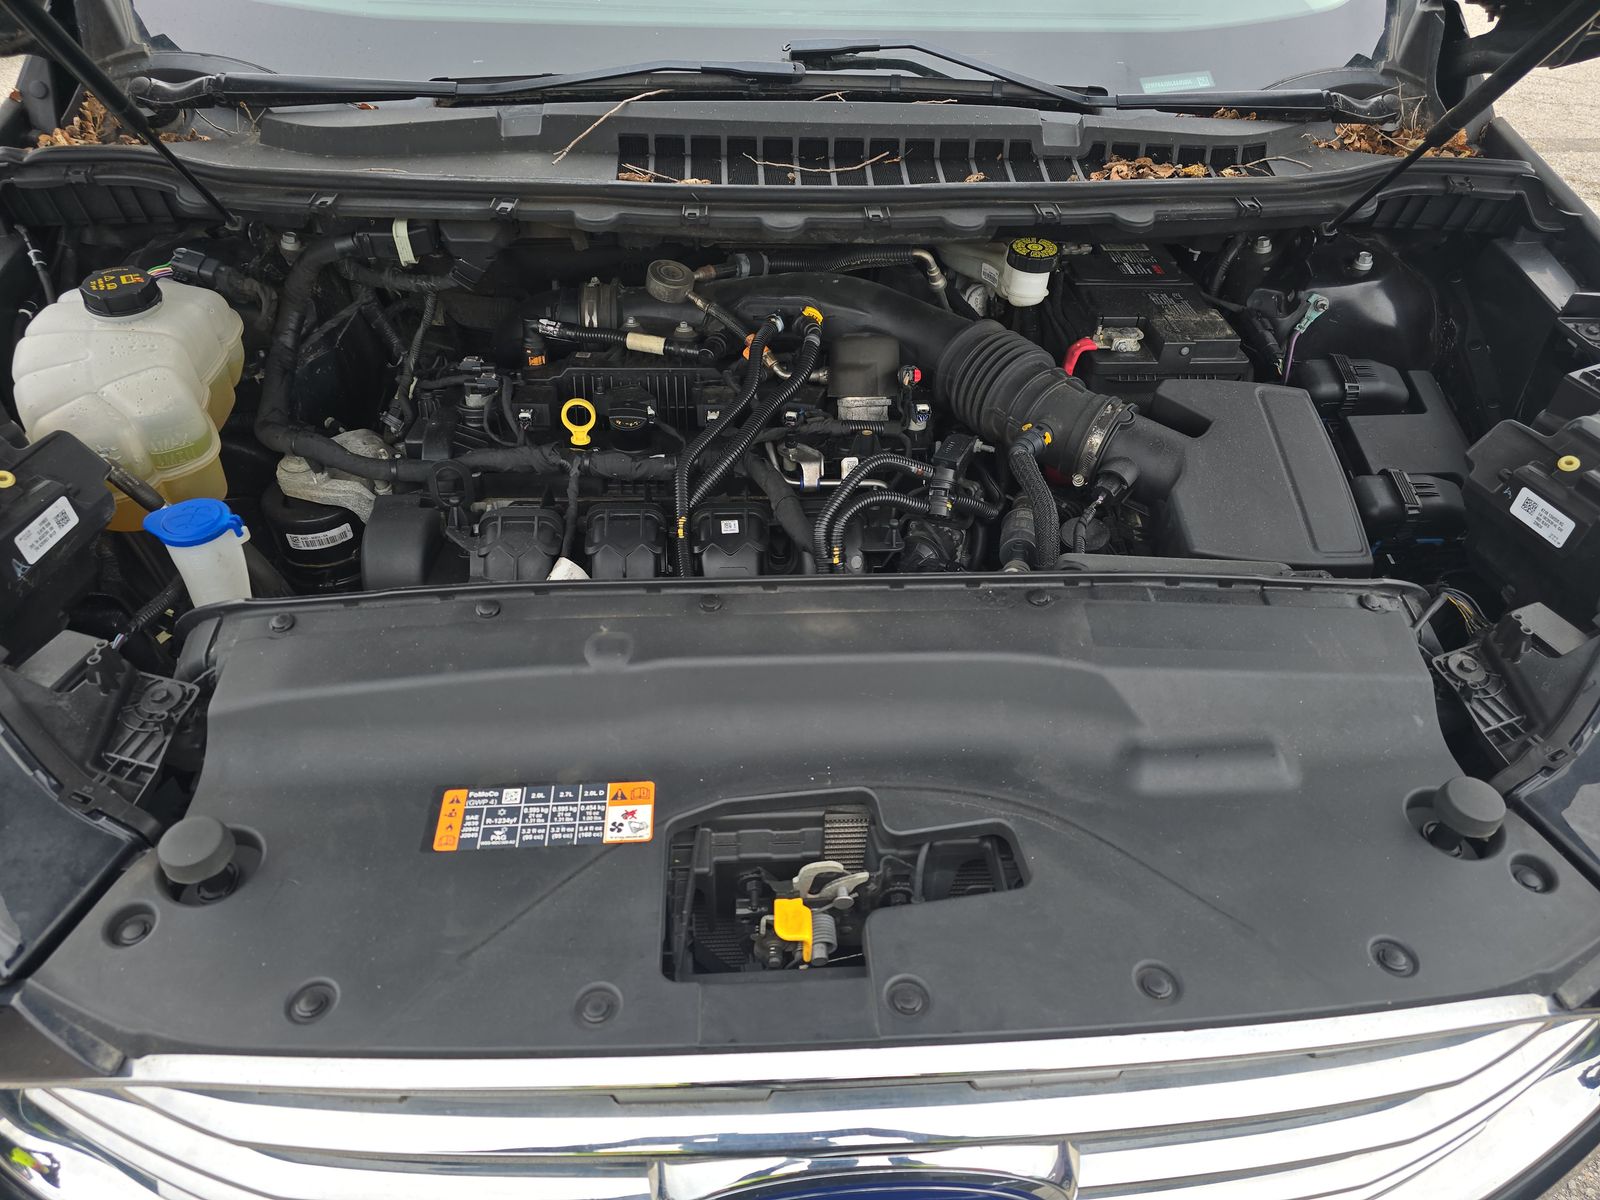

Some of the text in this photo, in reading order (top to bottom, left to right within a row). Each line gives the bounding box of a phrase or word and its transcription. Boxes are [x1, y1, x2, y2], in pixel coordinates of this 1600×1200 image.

[569, 805, 577, 813] kg
[597, 804, 606, 812] kg
[485, 817, 518, 825] R-1234yf
[490, 834, 507, 842] PAG
